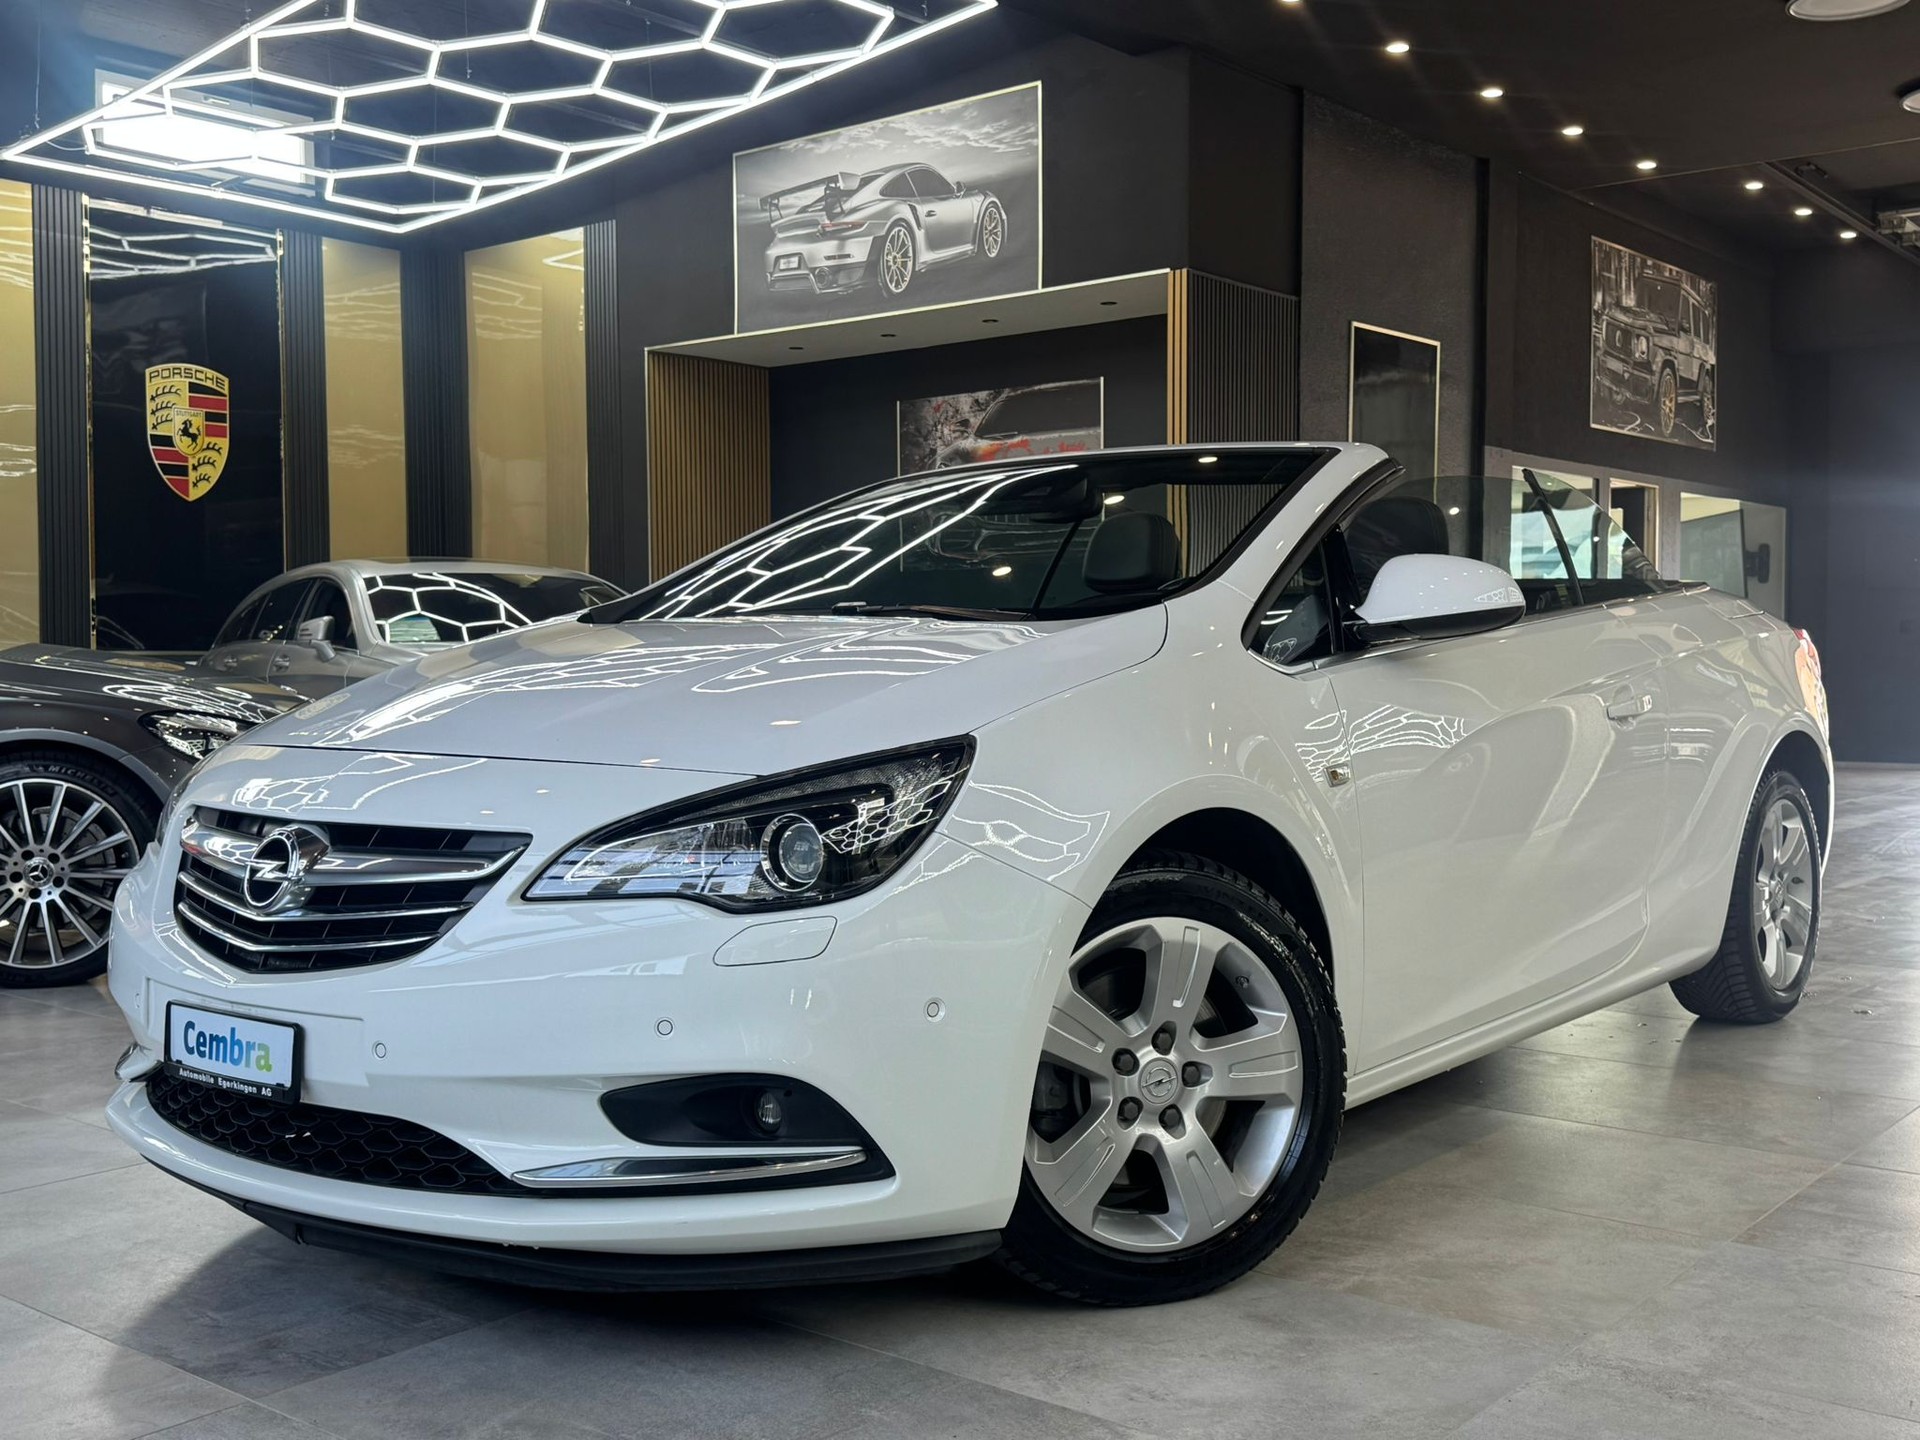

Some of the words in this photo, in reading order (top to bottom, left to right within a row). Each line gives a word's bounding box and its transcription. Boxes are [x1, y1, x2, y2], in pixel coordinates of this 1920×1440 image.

[149, 367, 225, 390] PORSCHE
[48, 765, 118, 797] MICHELIN
[184, 1020, 272, 1072] Cembra
[179, 1067, 214, 1084] Automobile
[218, 1077, 257, 1094] Egerkingen
[261, 1087, 272, 1097] AG
